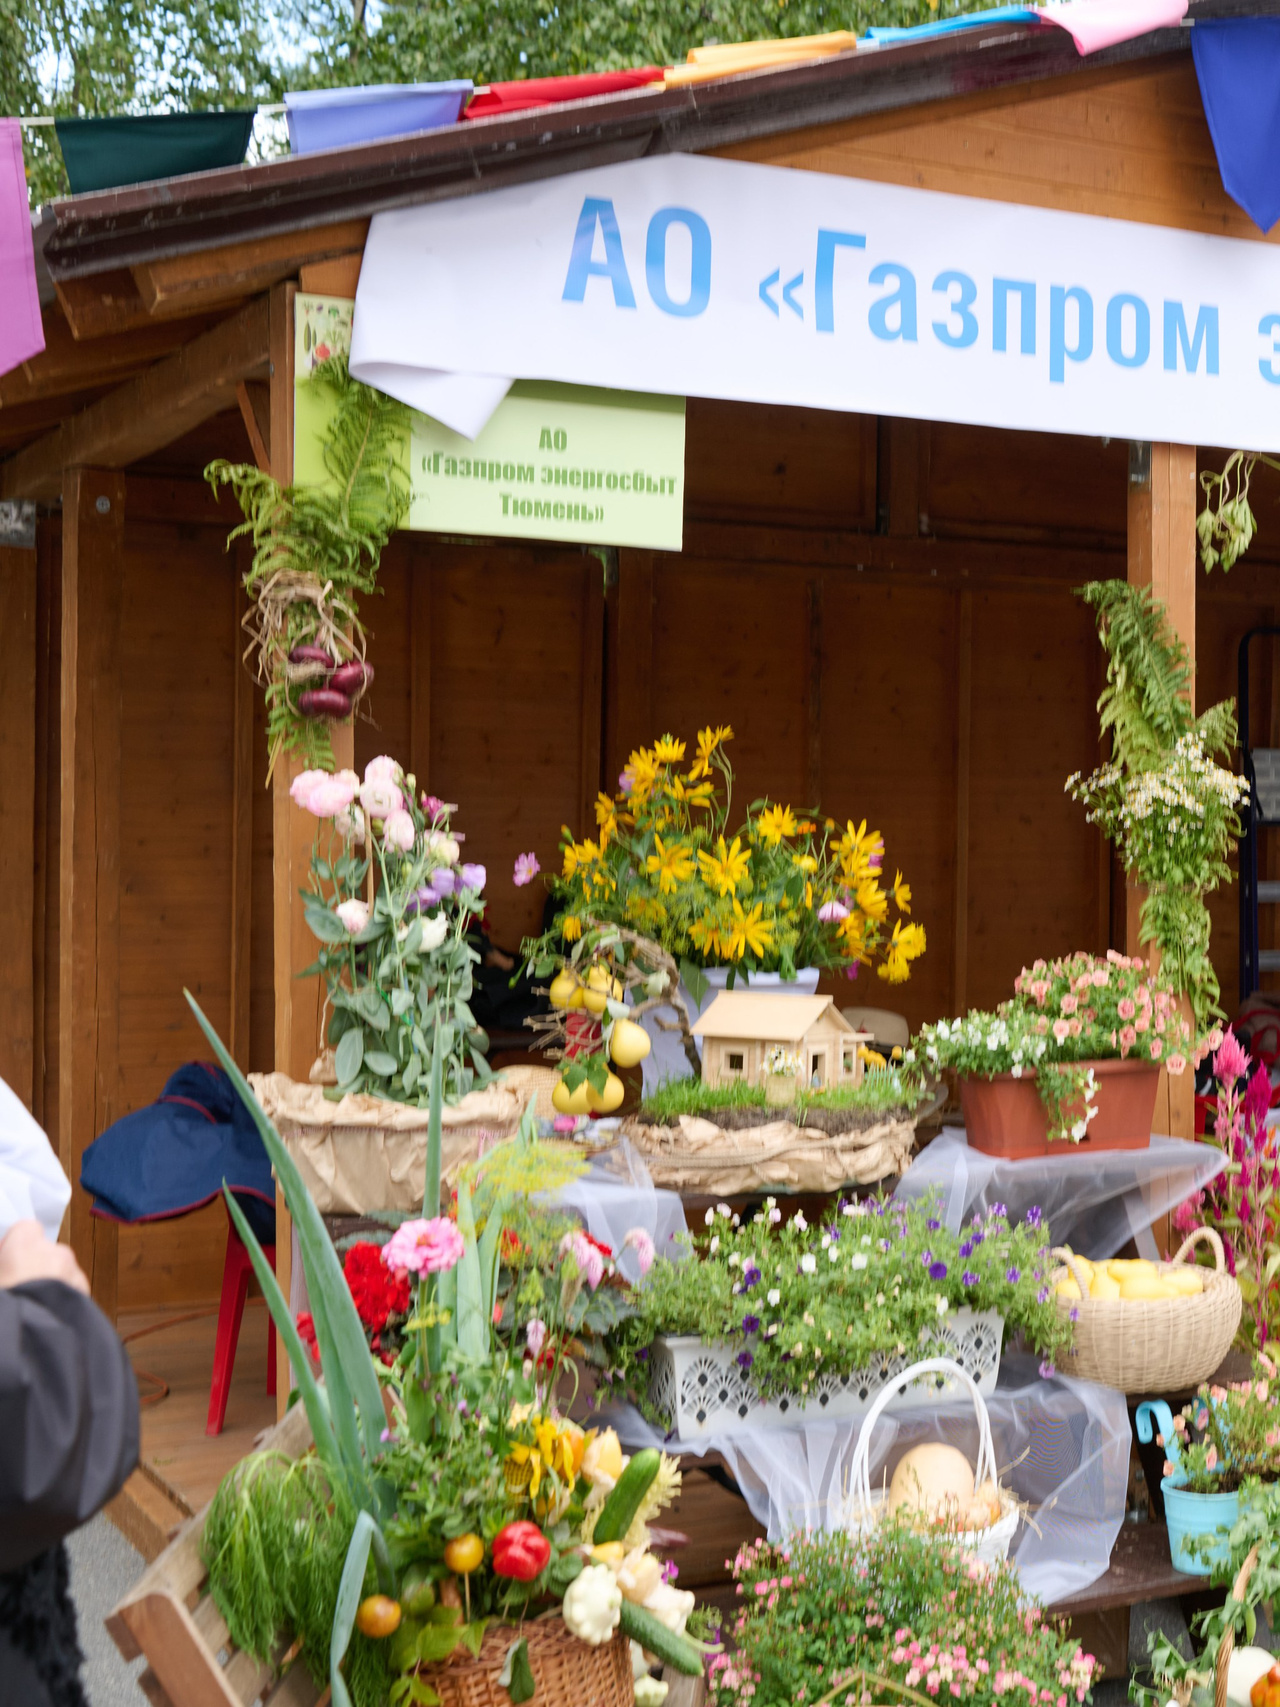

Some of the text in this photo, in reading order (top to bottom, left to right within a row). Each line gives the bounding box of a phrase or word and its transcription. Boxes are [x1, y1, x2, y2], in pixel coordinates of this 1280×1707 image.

[561, 195, 713, 319] АО
[758, 226, 1220, 385] «Газпром
[538, 427, 568, 452] АО
[421, 450, 677, 495] «Газпром энергосбыт
[500, 493, 605, 522] Тюмень»
